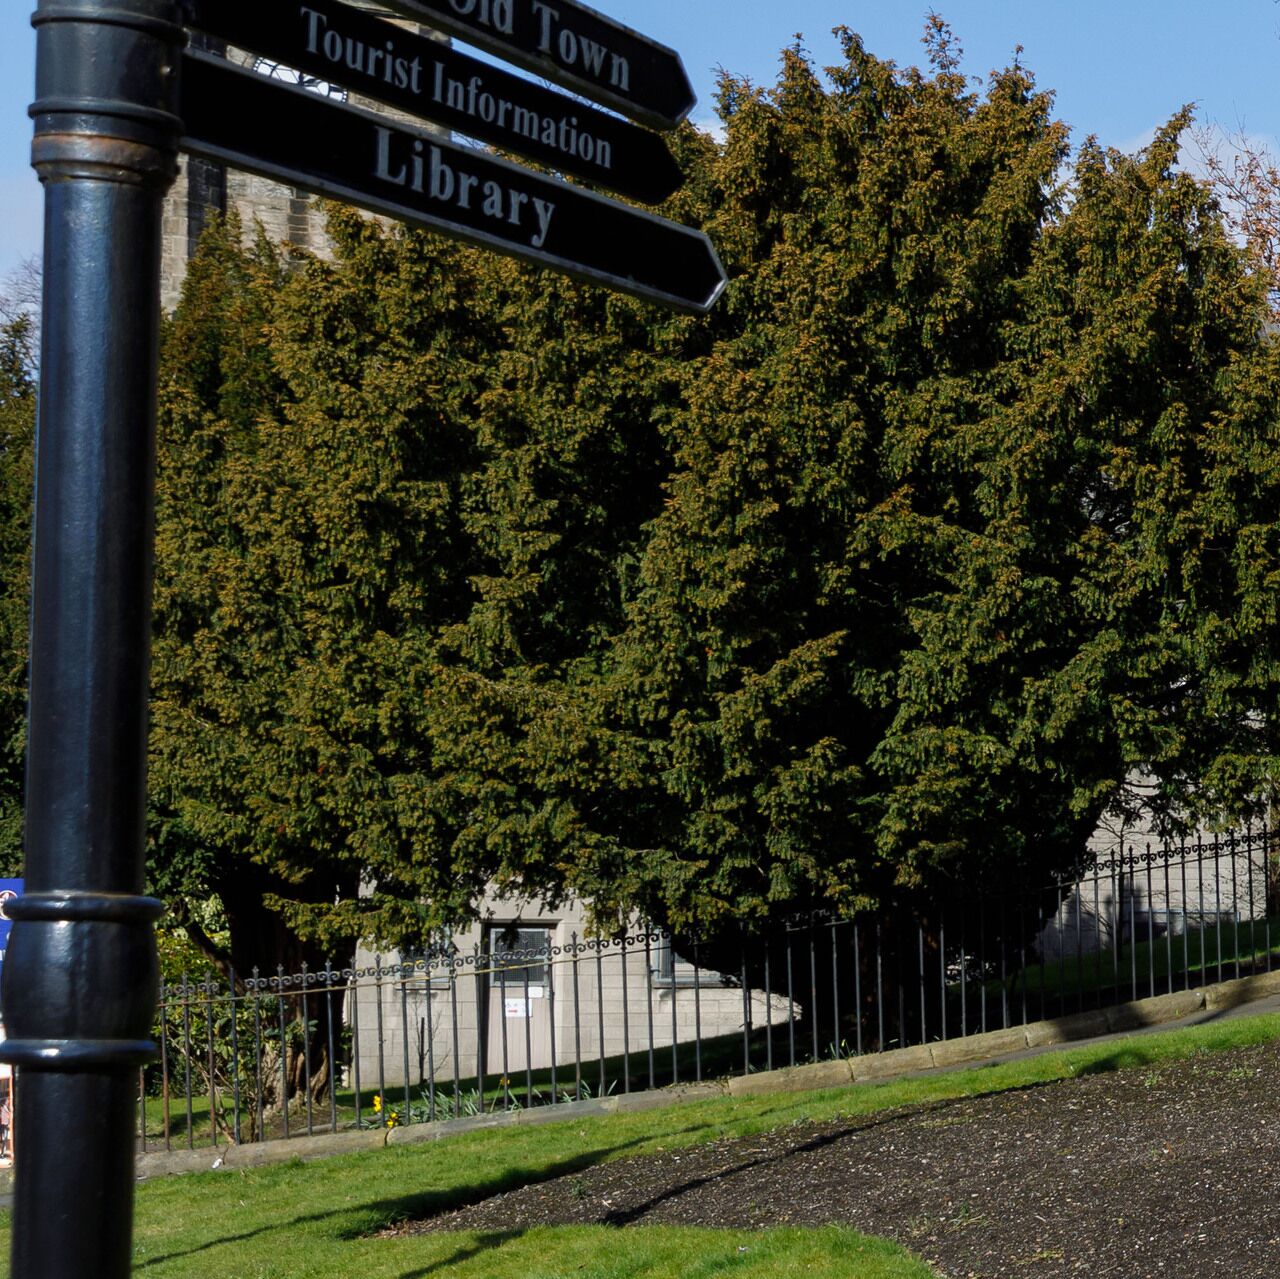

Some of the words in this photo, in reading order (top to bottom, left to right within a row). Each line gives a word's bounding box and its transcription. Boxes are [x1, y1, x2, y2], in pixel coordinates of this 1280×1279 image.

[301, 5, 424, 94] Tourist
[431, 60, 612, 169] Information
[531, 0, 630, 92] Town
[373, 125, 556, 249] Library
